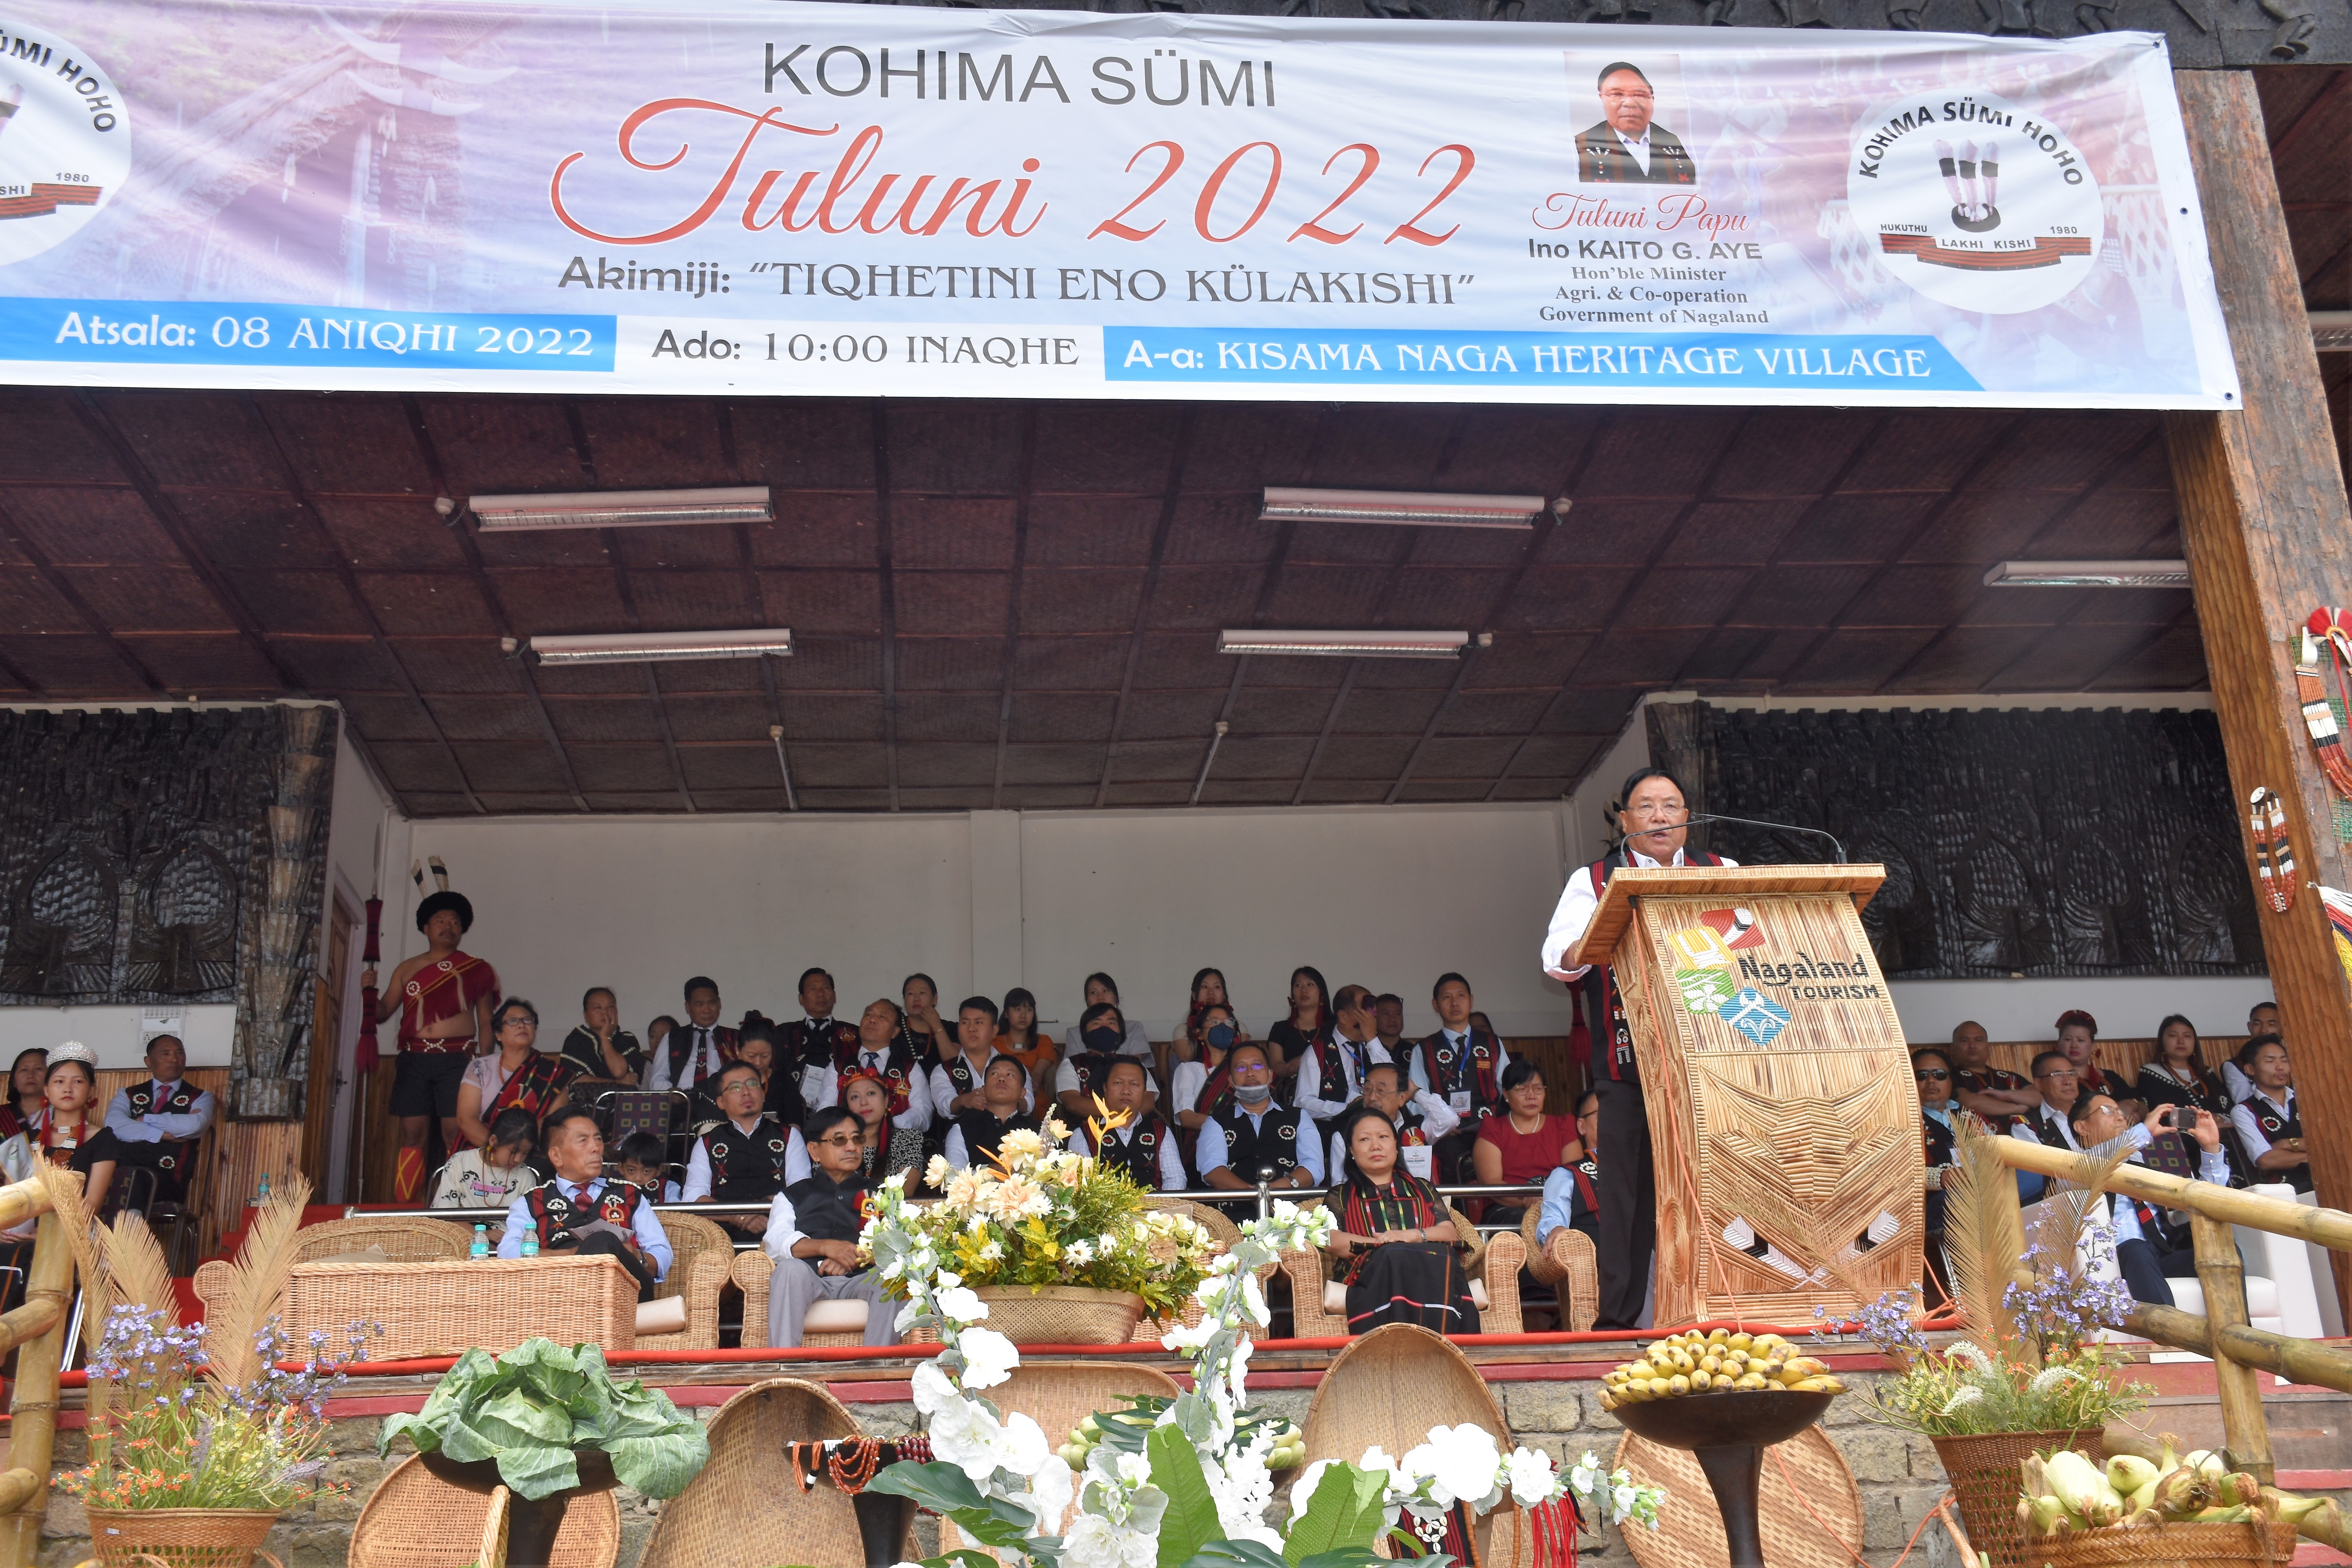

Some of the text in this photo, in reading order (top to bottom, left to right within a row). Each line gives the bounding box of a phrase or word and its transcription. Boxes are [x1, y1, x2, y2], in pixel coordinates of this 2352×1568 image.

[765, 43, 1275, 107] KOHIMA SÜMI
[57, 58, 116, 132] HOHO
[1860, 97, 2082, 185] KOHIMA SÜMI HOHO
[56, 172, 89, 182] 1980
[552, 99, 1475, 246] Tuluni 2022
[1533, 193, 1749, 241] Tuluni Papu
[1880, 224, 1927, 232] HUKUTHU
[1529, 239, 1762, 260] Ino KAITO G. AYE
[1942, 239, 2031, 249] LAKHI KISHI
[558, 257, 1474, 304] Akimiji: “TIQHETINI ENO KÜLAKISHI”
[1571, 267, 1726, 281] Hon’ble Minister
[1555, 286, 1748, 306] Agri. & Co-operation
[56, 312, 593, 356] Atsala: 08 ANIQHI 2022
[1540, 307, 1769, 326] Government of Nagaland
[652, 329, 1079, 368] Ado: 10:00 INAQHE
[1124, 340, 1930, 376] A-a: KISAMA NAGA HERITAGE VILLAGE
[1739, 951, 1869, 986] Nagaland
[1789, 985, 1880, 1000] TOURISM
